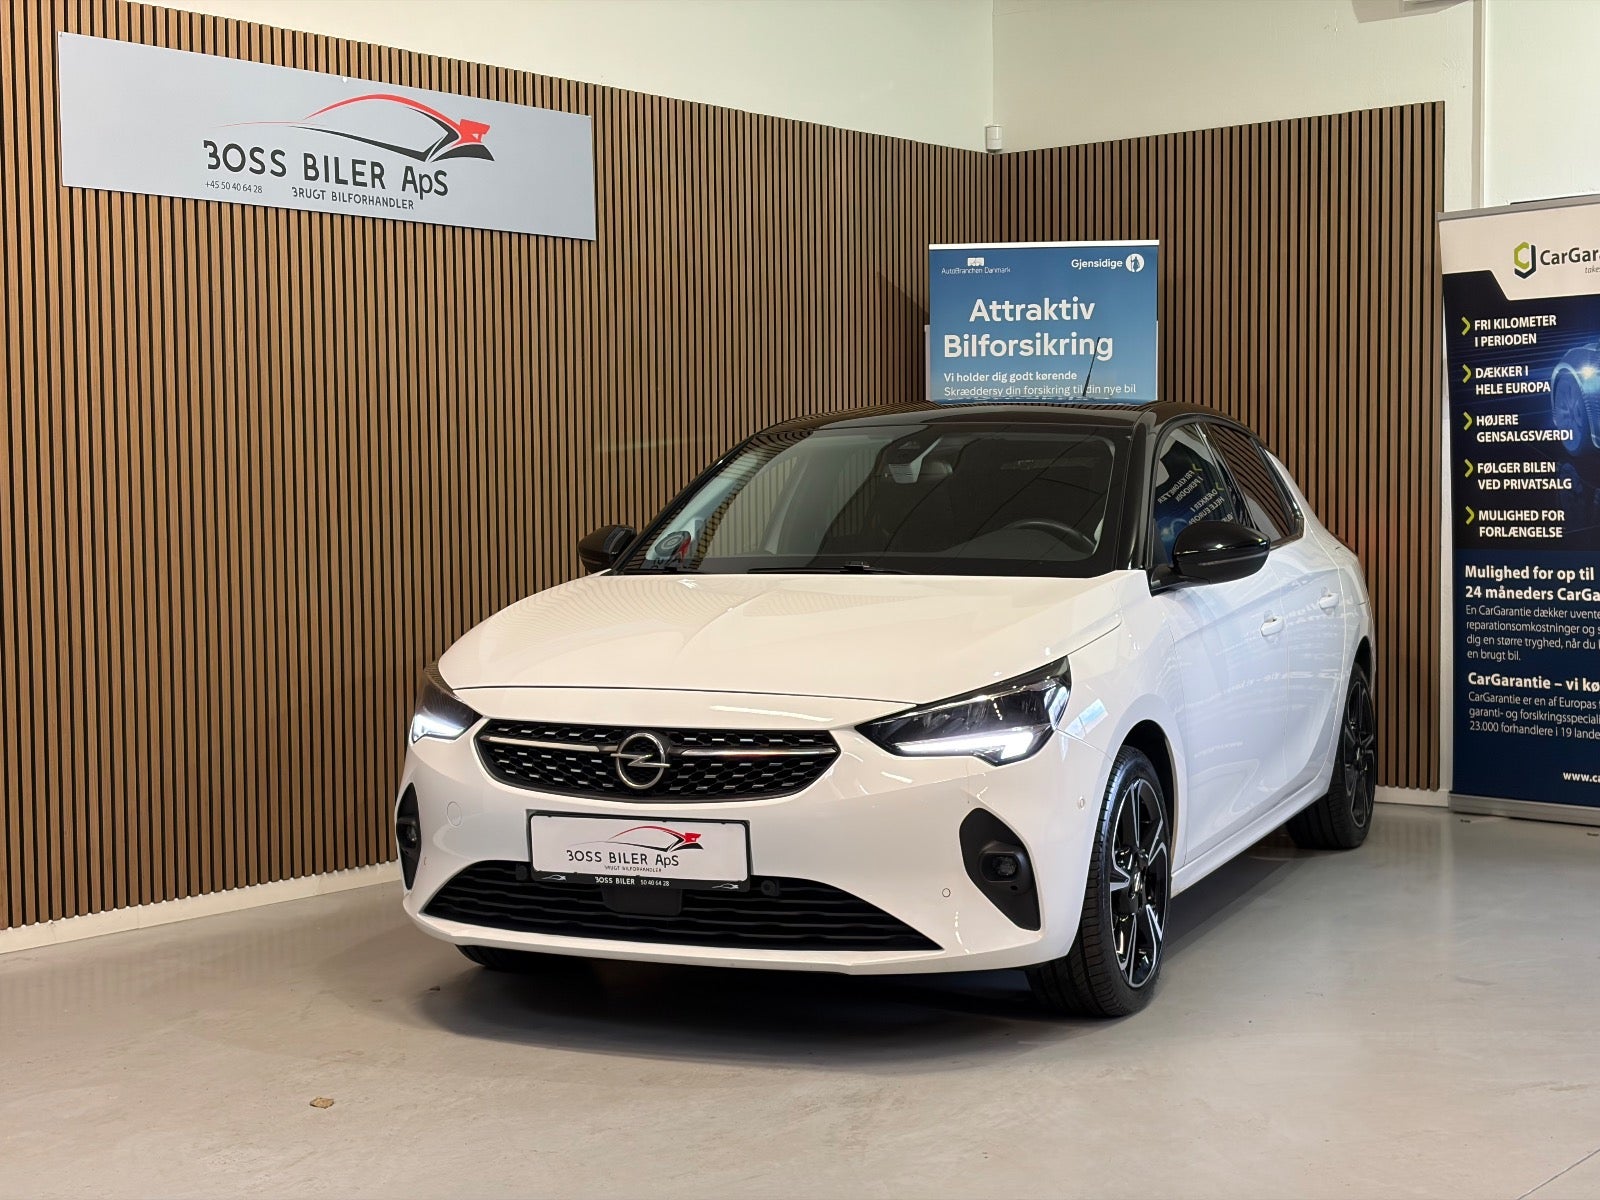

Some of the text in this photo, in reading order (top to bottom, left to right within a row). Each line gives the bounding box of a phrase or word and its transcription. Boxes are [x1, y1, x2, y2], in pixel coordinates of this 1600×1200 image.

[203, 140, 449, 200] BOSS BILER ApS
[204, 180, 263, 194] +45 50 40 64 28
[292, 187, 414, 210] BRUGT BILFORHANDLER
[1540, 247, 1600, 266] CarGar
[941, 267, 982, 275] AutoBranchen
[1071, 258, 1123, 270] Gjensidige
[969, 296, 1096, 322] Attraktiv
[1474, 314, 1557, 332] FRI KILOMETER
[944, 332, 1113, 362] Bilforsikring
[1474, 333, 1537, 348] I PERIODEN
[944, 371, 1077, 383] Vi holder dig godt kørende
[1475, 365, 1529, 379] DÆKKER I
[944, 384, 1136, 398] Skræddersy din forsikring til din nye bil
[1476, 381, 1551, 395] HELE EUROPA
[1476, 414, 1519, 428] HØJERE
[1476, 429, 1573, 443] GENSALGSVÆRDI
[1477, 461, 1556, 475] FØLGER BILEN
[1478, 478, 1572, 491] VED PRIVATSALG
[1478, 509, 1565, 522] MULIGHED FOR
[1479, 525, 1563, 538] FORLÆNGELSE
[1465, 565, 1595, 583] Mulighed for op til
[1465, 586, 1482, 599] 24
[1485, 585, 1554, 600] måneders
[1466, 605, 1477, 615] En
[1478, 606, 1532, 617] CarGarantie
[1533, 608, 1568, 619] dækker
[1466, 620, 1580, 636] reparationsomkostninger
[1582, 625, 1595, 637] og
[1467, 635, 1481, 647] dig
[1483, 638, 1495, 646] en
[1496, 636, 1523, 647] større
[1524, 638, 1563, 650] tryghed,
[1565, 639, 1581, 649] når
[1583, 639, 1596, 650] du
[1467, 650, 1521, 663] en brugt bil.
[1468, 672, 1551, 690] CarGarantie
[1565, 678, 1579, 691] vi
[1468, 692, 1521, 705] CarGarantie
[1523, 697, 1532, 705] er
[1534, 697, 1546, 706] en
[1548, 696, 1558, 707] af
[1559, 697, 1597, 711] Europas
[1469, 707, 1504, 719] garanti-
[1505, 710, 1518, 721] og
[1469, 721, 1499, 732] 23.000
[1501, 723, 1554, 737] forhandlere
[1561, 727, 1572, 738] 19
[566, 849, 680, 869] BOSS BILER ApS
[595, 876, 613, 884] BOSS
[615, 877, 635, 885] BILER
